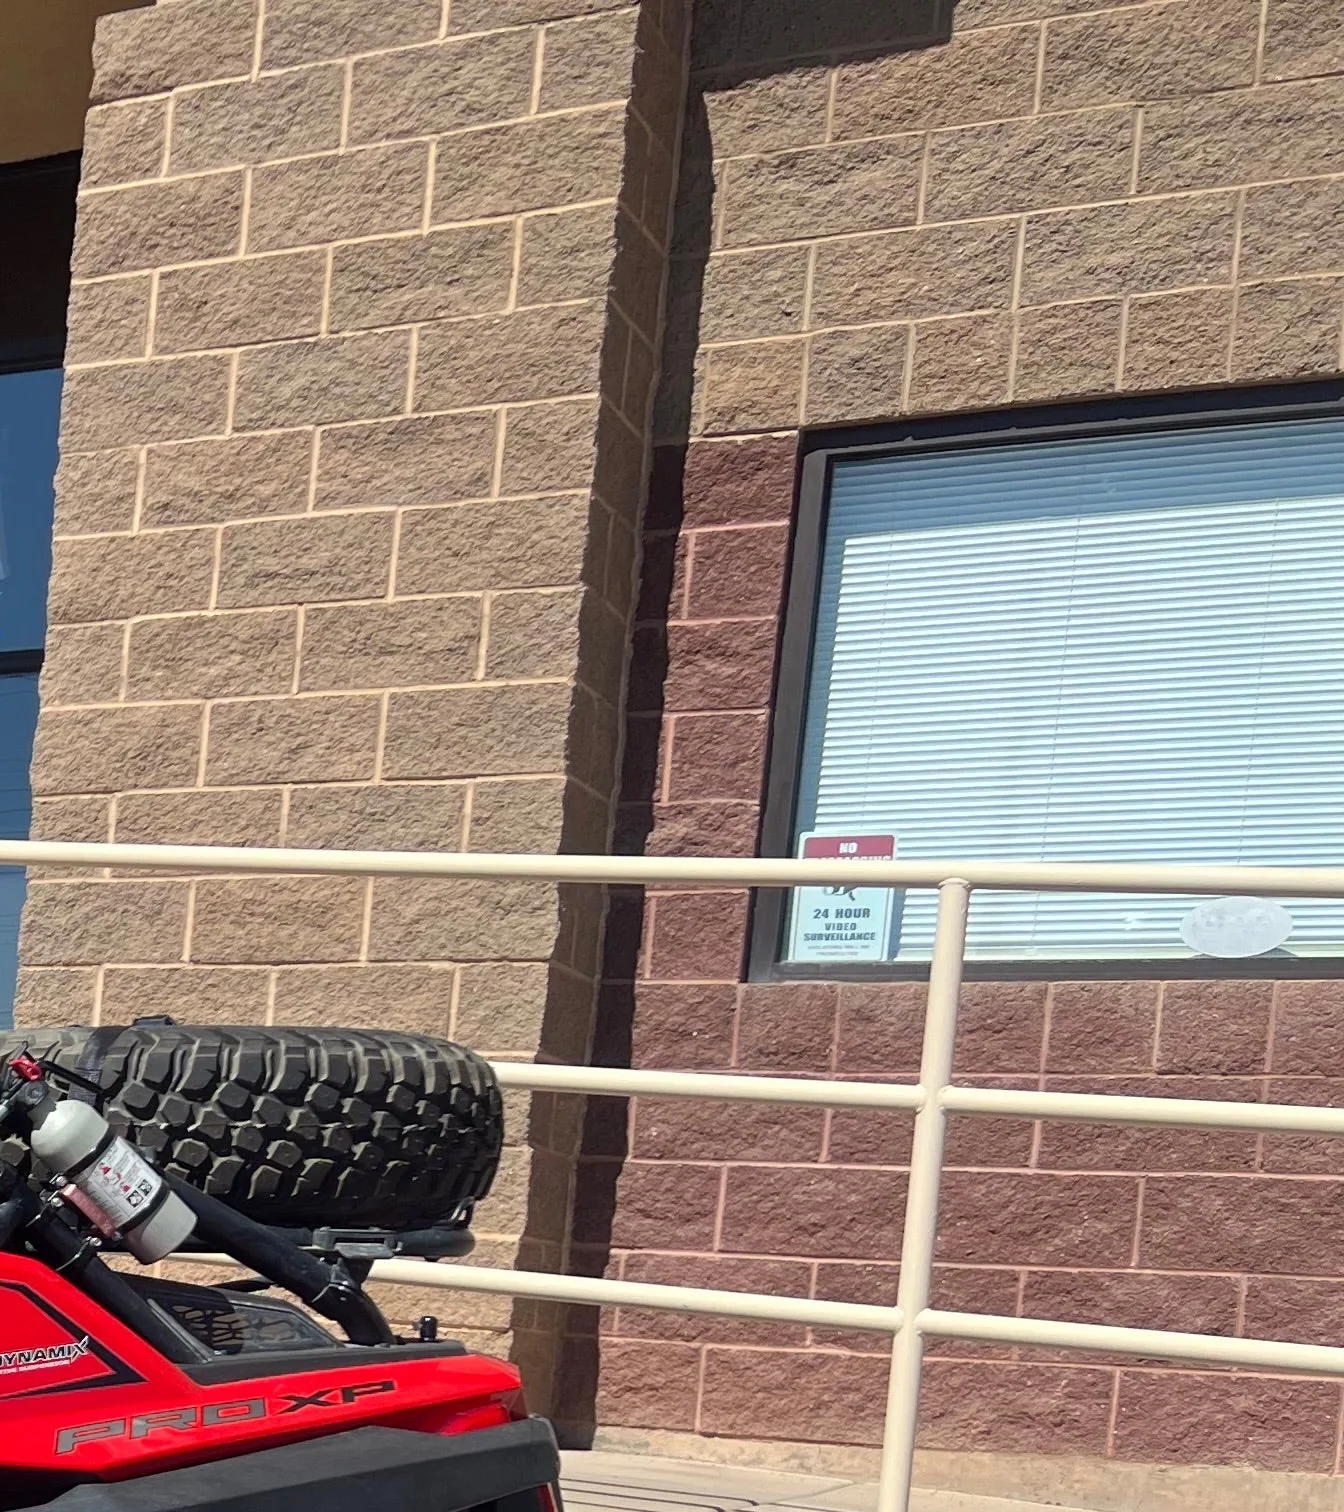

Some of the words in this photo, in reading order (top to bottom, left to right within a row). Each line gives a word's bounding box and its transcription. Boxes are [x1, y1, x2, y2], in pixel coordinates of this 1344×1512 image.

[839, 842, 858, 854] NO
[813, 908, 830, 919] 24
[835, 908, 871, 919] HOUR
[825, 922, 857, 931] VIDEO
[803, 932, 876, 942] SURVEILLANCE
[54, 1397, 267, 1456] PRO
[277, 1380, 395, 1415] XP
